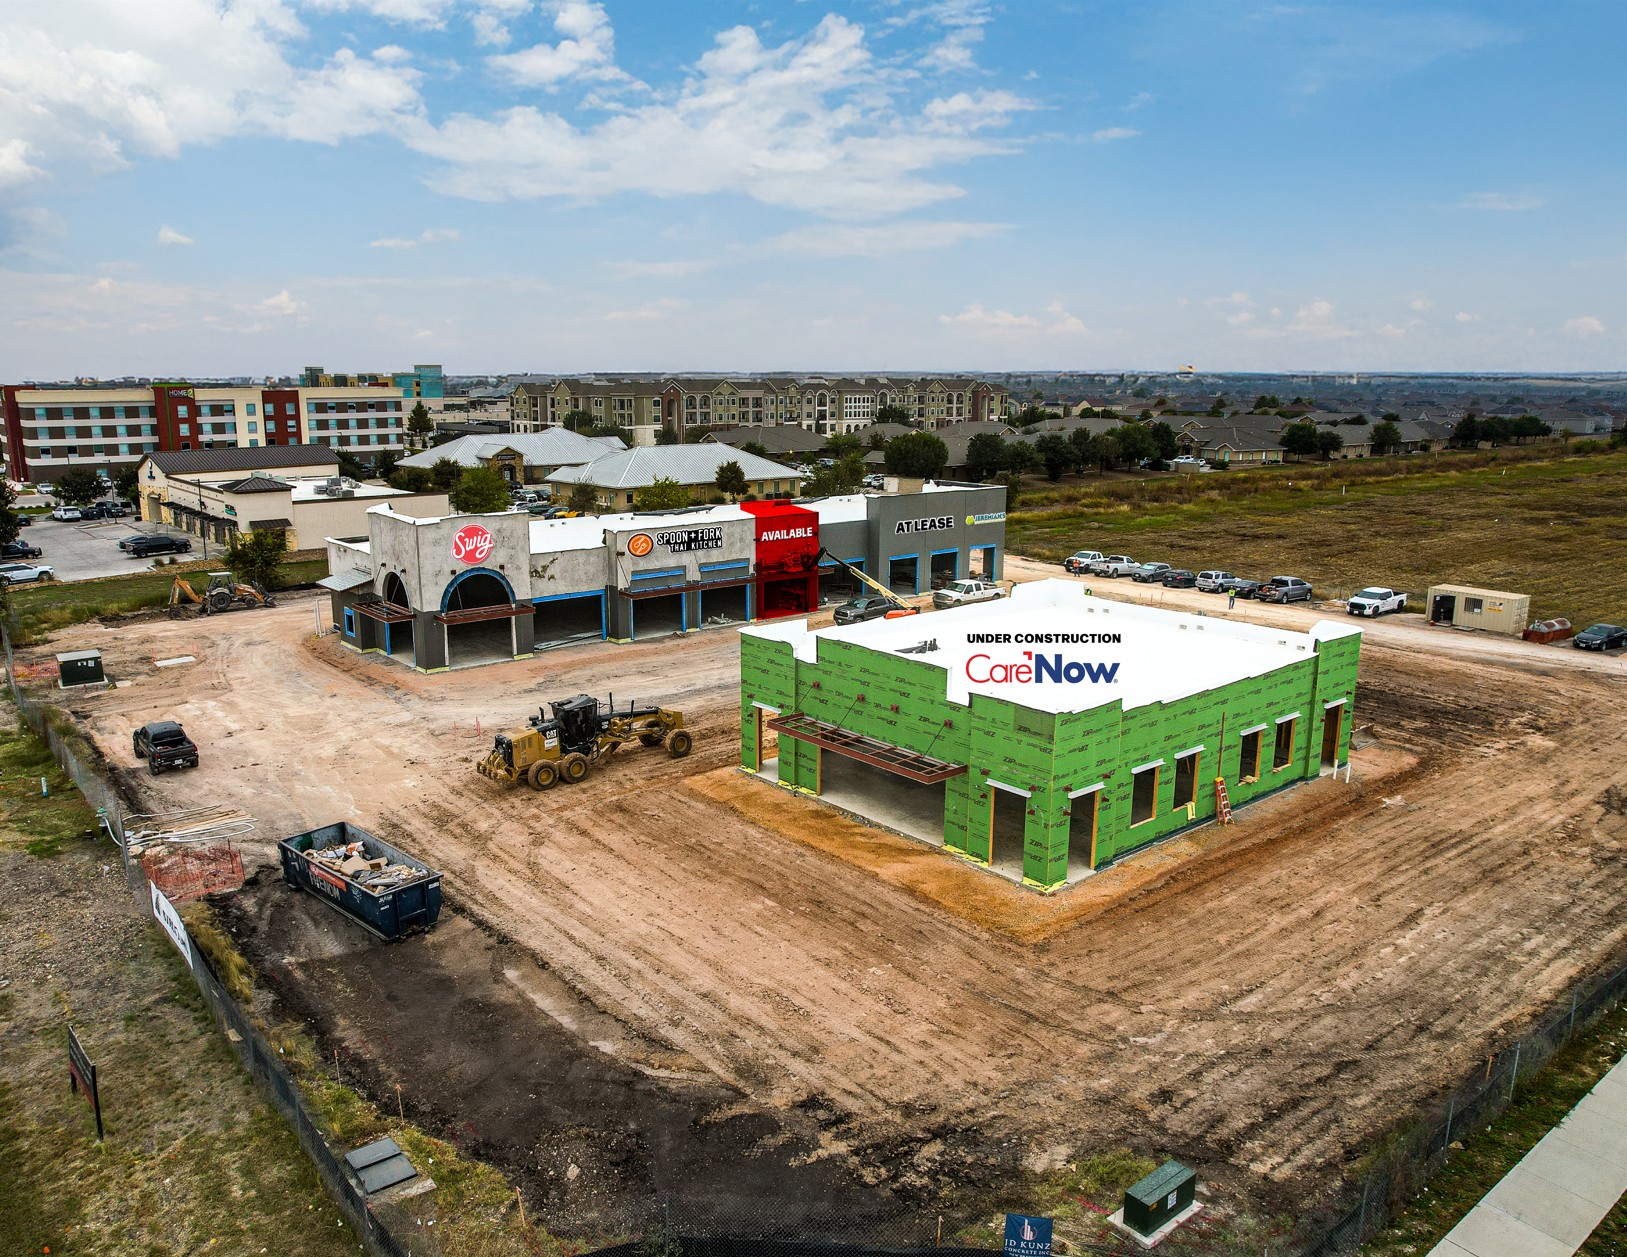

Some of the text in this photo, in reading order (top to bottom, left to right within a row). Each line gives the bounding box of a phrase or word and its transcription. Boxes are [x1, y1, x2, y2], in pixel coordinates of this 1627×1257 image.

[546, 729, 556, 738] CAT
[1020, 1241, 1050, 1250] KUNZ
[1004, 1246, 1037, 1255] CONCRETE
